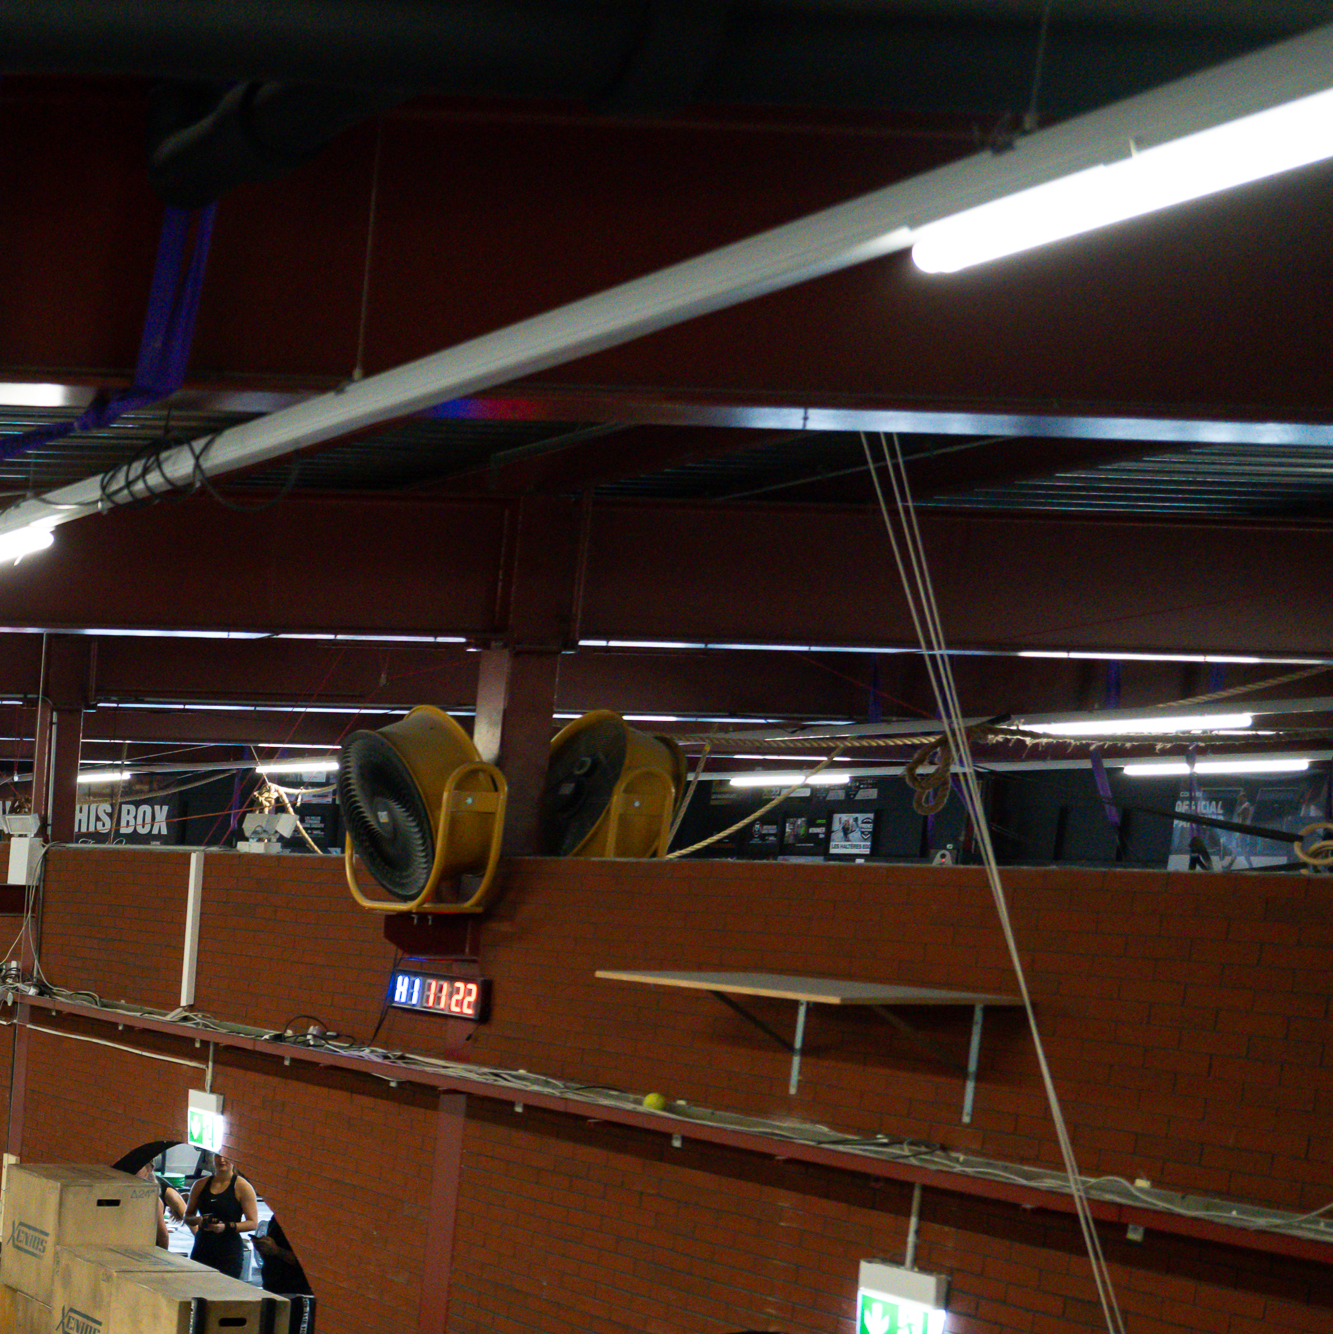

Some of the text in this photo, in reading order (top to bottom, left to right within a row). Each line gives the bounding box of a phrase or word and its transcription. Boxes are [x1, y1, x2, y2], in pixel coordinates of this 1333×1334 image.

[75, 803, 112, 834] HIS
[120, 804, 169, 835] BOX
[7, 1219, 50, 1260] XENIOS
